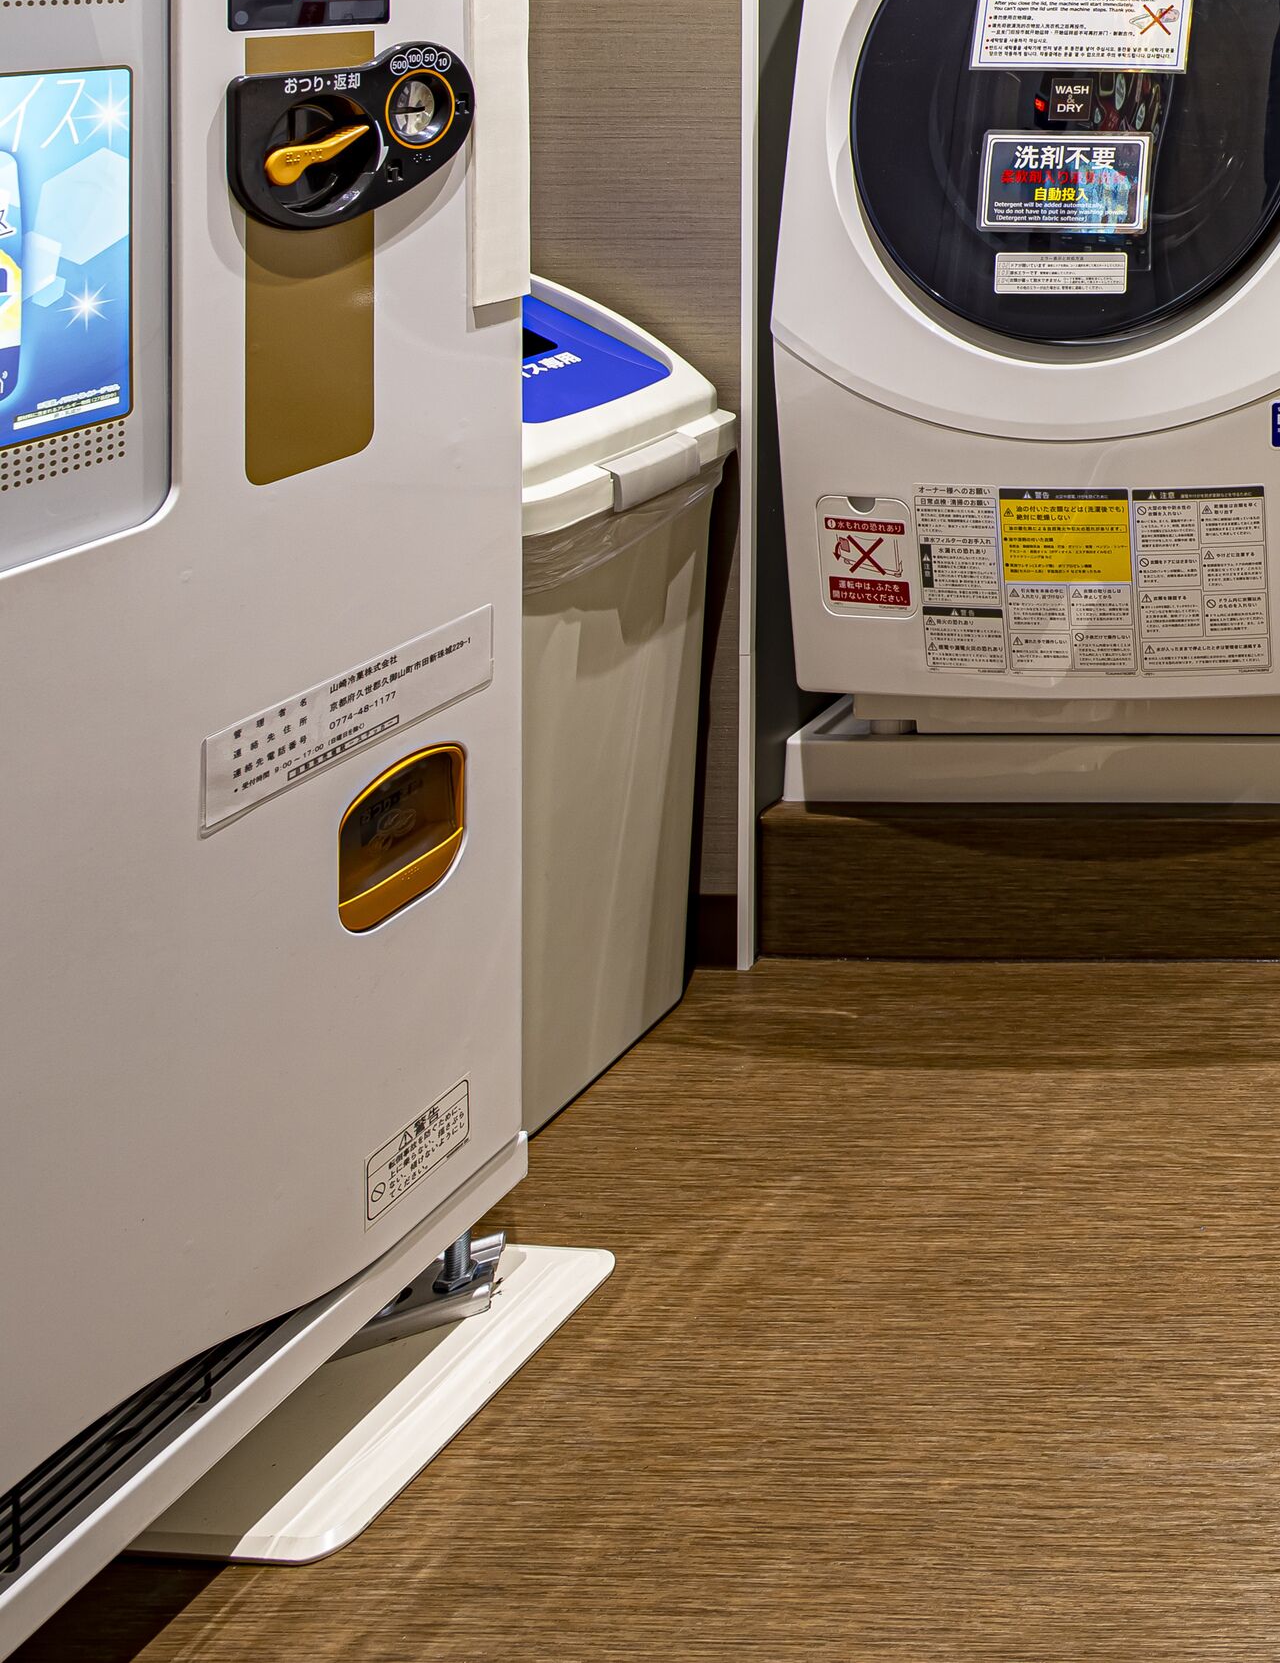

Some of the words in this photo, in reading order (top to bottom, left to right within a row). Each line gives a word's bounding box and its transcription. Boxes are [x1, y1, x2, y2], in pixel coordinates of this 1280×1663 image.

[408, 52, 421, 64] 100
[423, 52, 435, 63] 50
[438, 56, 448, 68] 10
[392, 59, 407, 71] 500
[284, 74, 361, 95] おつり・返却
[1055, 86, 1089, 94] WASH
[1057, 104, 1083, 112] DRY
[1014, 145, 1116, 170] 洗剤不要
[1034, 187, 1088, 201] 自動投入
[836, 520, 902, 534] 水もれの恐れあり
[838, 580, 900, 594] 運転中は、ふたを
[832, 590, 908, 604] 開けないでください。
[329, 691, 396, 730] 0774-48-1177
[414, 1106, 441, 1136] 警告
